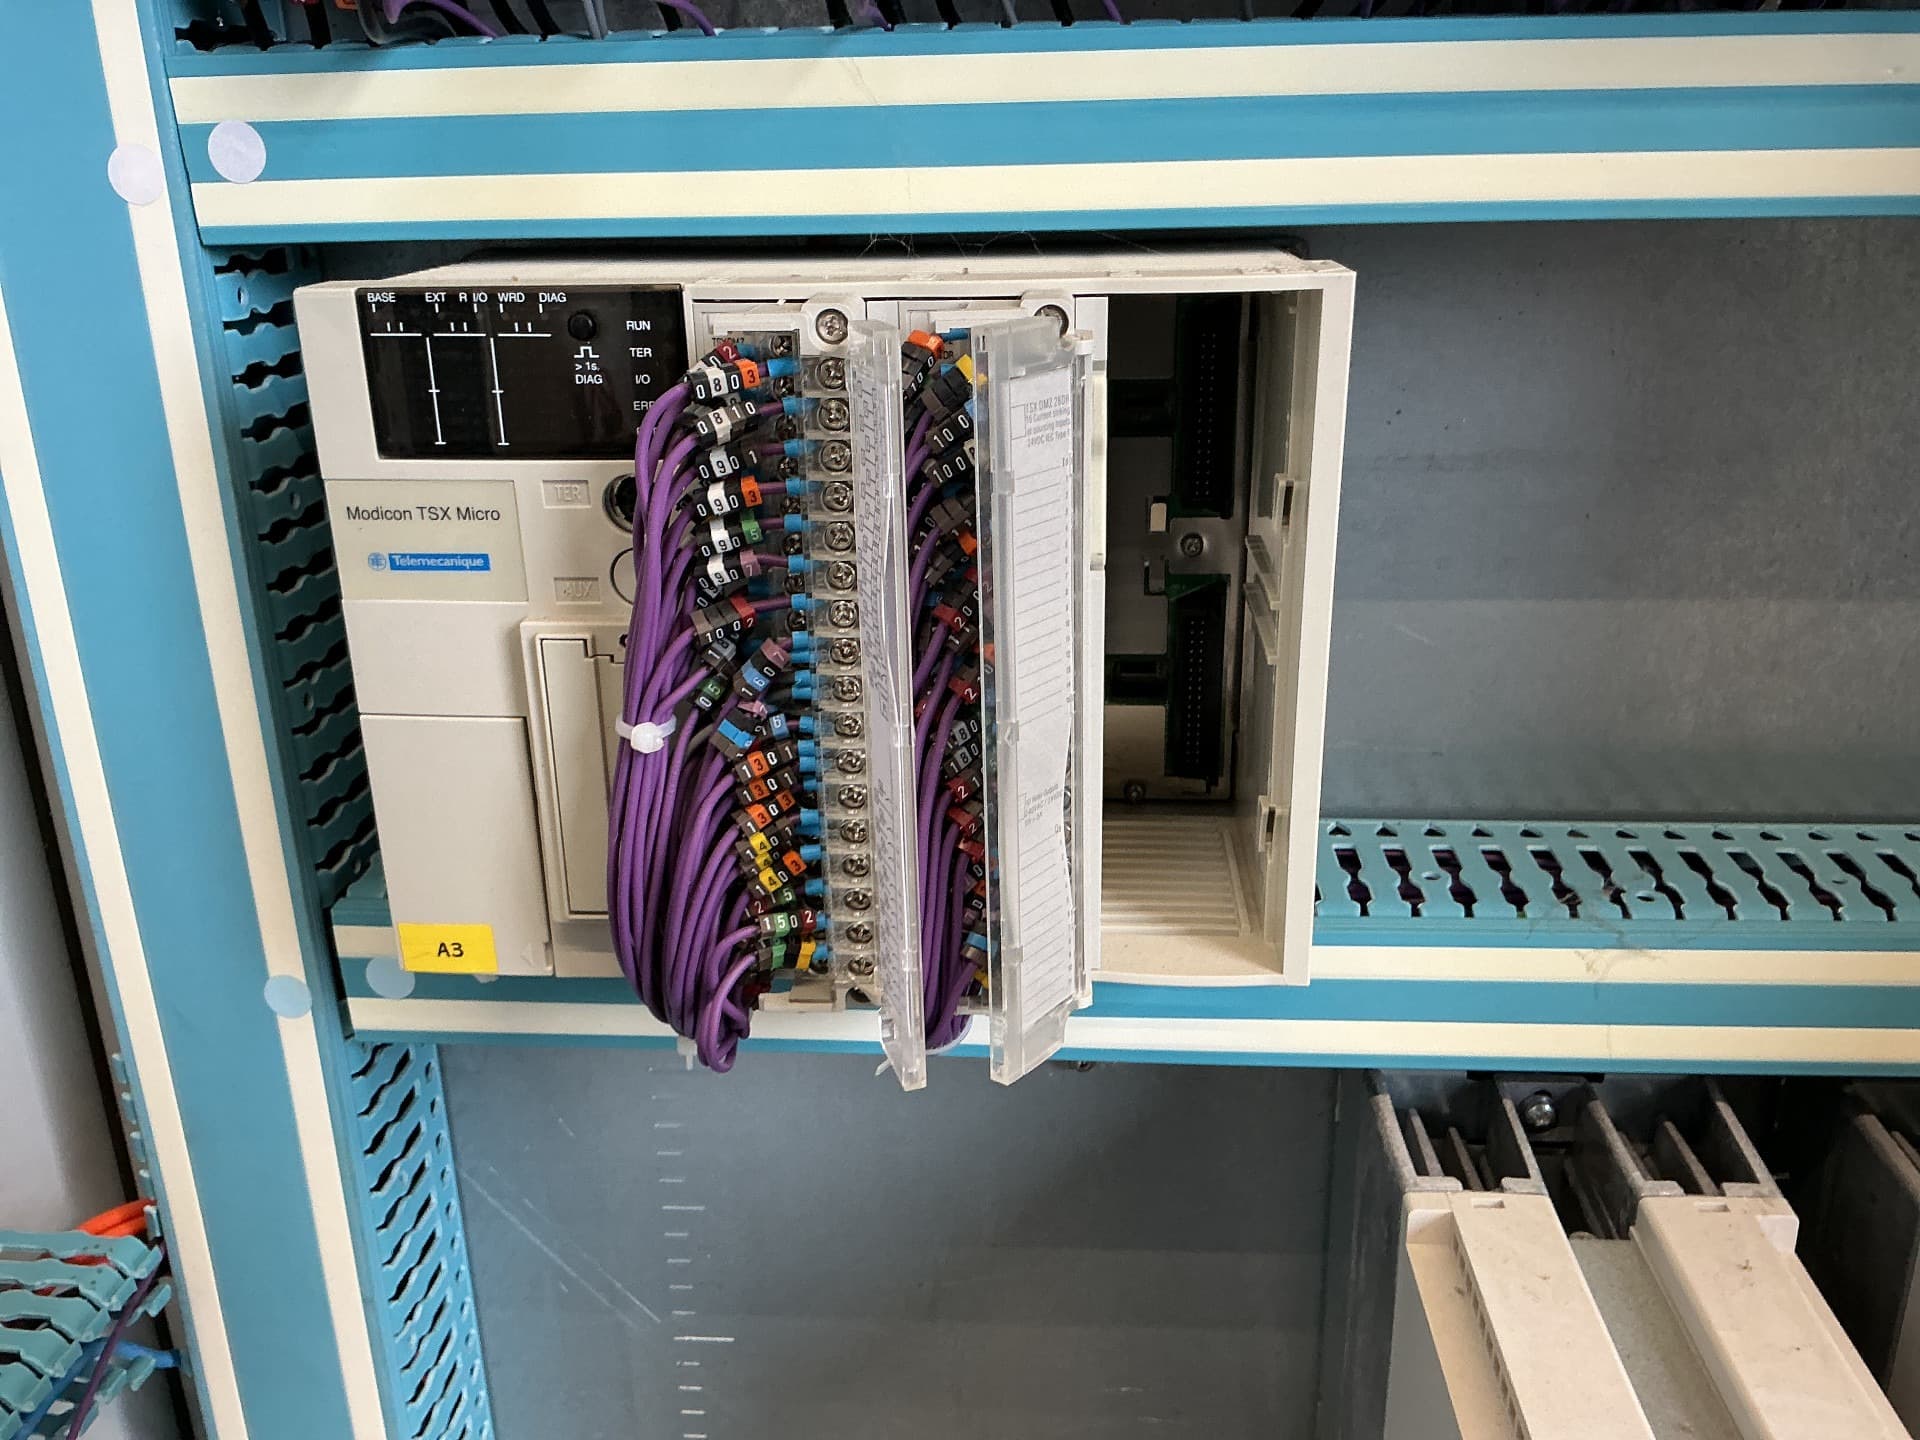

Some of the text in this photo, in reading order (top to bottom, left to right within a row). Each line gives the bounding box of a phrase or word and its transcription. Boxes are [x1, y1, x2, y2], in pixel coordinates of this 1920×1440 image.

[367, 292, 396, 303] BASE
[425, 292, 446, 303] EXT
[459, 292, 488, 303] R I/O
[498, 292, 525, 303] WRD
[539, 292, 567, 303] DIAG
[626, 320, 651, 331] RUN
[629, 347, 652, 358] TER
[575, 373, 603, 385] DIAG
[635, 374, 651, 385] I/O
[695, 369, 756, 399] 0803
[697, 401, 756, 435] 0810
[699, 450, 758, 479] 0901
[554, 485, 581, 499] TER
[697, 490, 757, 517] 0903
[346, 506, 501, 521] Modicon TSX Micro
[701, 528, 760, 557] 0905
[391, 555, 485, 570] Telemecanique
[699, 564, 753, 589] 0907
[564, 582, 593, 596] AUX
[742, 746, 794, 779] 1301
[743, 772, 794, 803] 1301
[747, 794, 792, 834] 1303
[763, 910, 814, 931] 1502
[437, 942, 465, 958] A3
